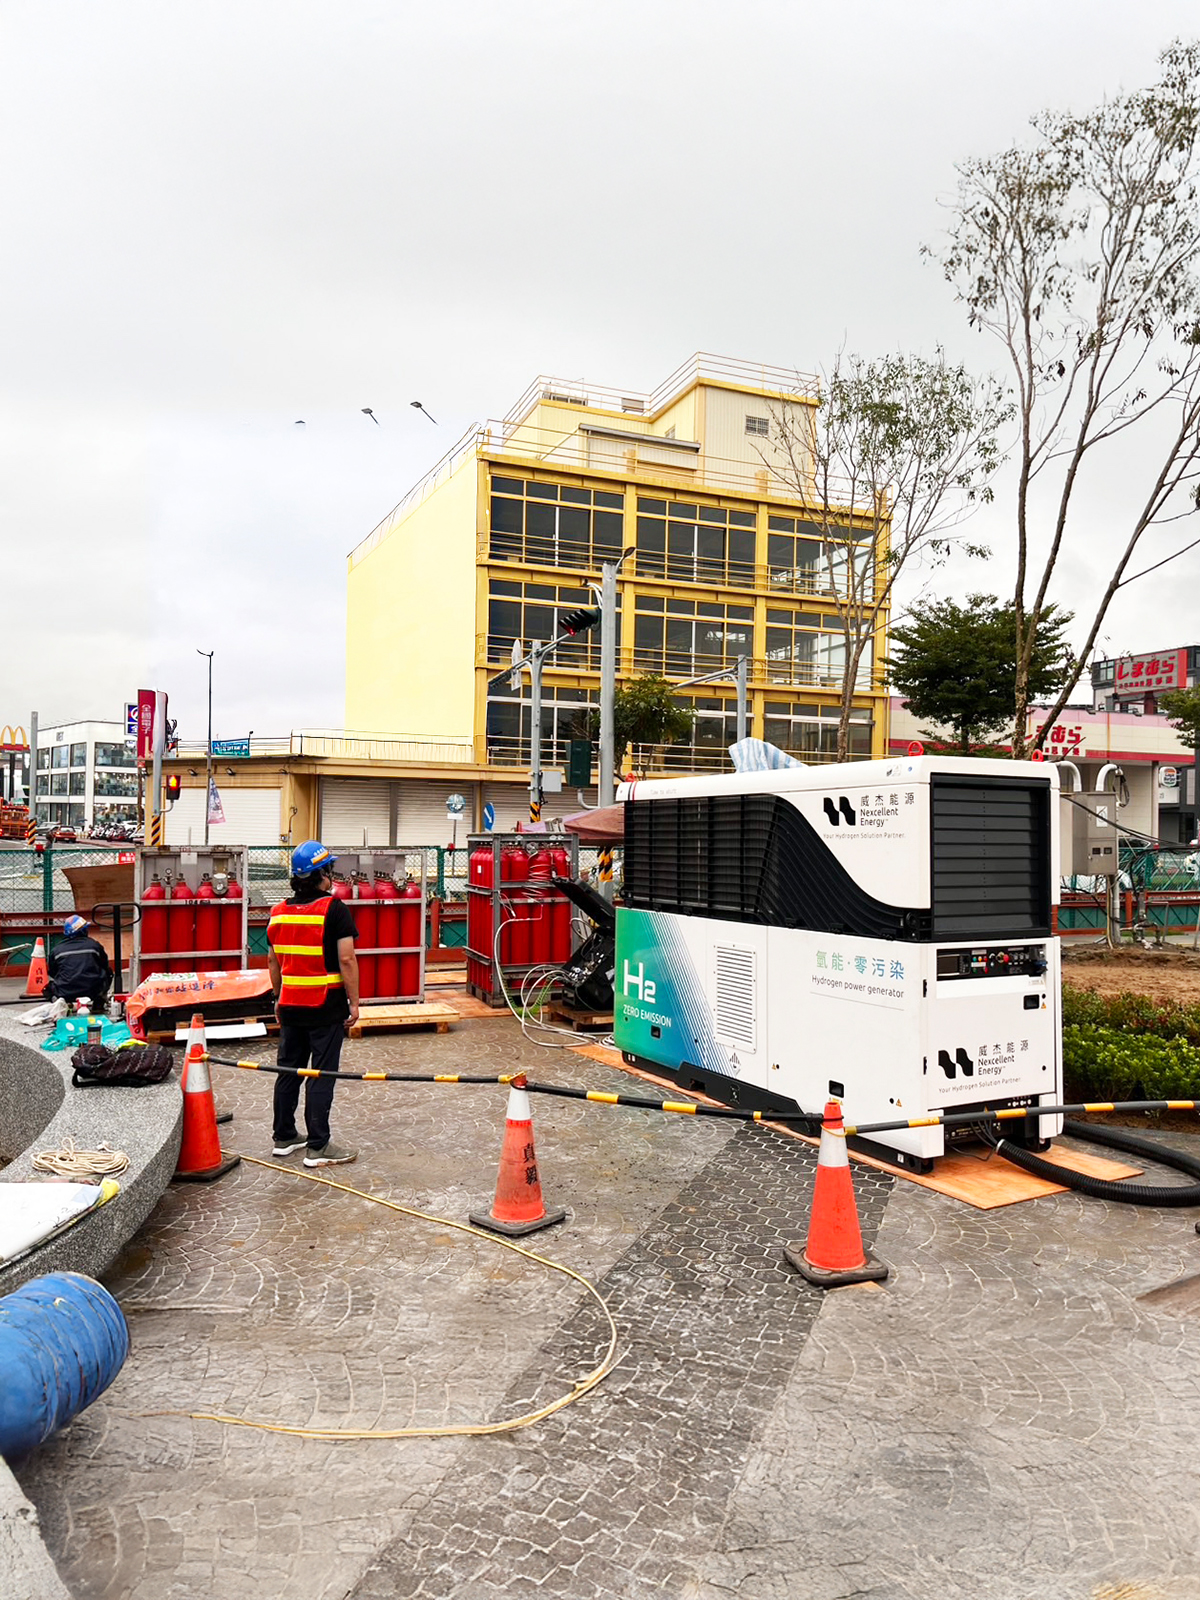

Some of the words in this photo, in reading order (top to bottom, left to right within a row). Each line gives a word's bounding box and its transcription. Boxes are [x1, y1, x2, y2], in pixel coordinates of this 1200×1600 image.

[1117, 656, 1177, 681] しまむら
[1023, 724, 1083, 744] むら
[860, 792, 915, 807] 威杰能源
[860, 807, 899, 817] Nexcellent
[860, 817, 885, 828] Energy
[835, 832, 860, 840] Hydrogen
[623, 959, 657, 1005] H2
[811, 974, 843, 989] Hydrogen
[844, 981, 866, 992] power
[867, 985, 905, 998] generator
[623, 1004, 640, 1018] ZERO
[640, 1009, 672, 1028] EMISSION
[978, 1039, 1029, 1056] 威杰能源
[977, 1055, 1015, 1066] Nexcellent
[977, 1065, 1003, 1076] Energy
[952, 1083, 978, 1092] Hydrogen
[978, 1080, 1001, 1089] Solution
